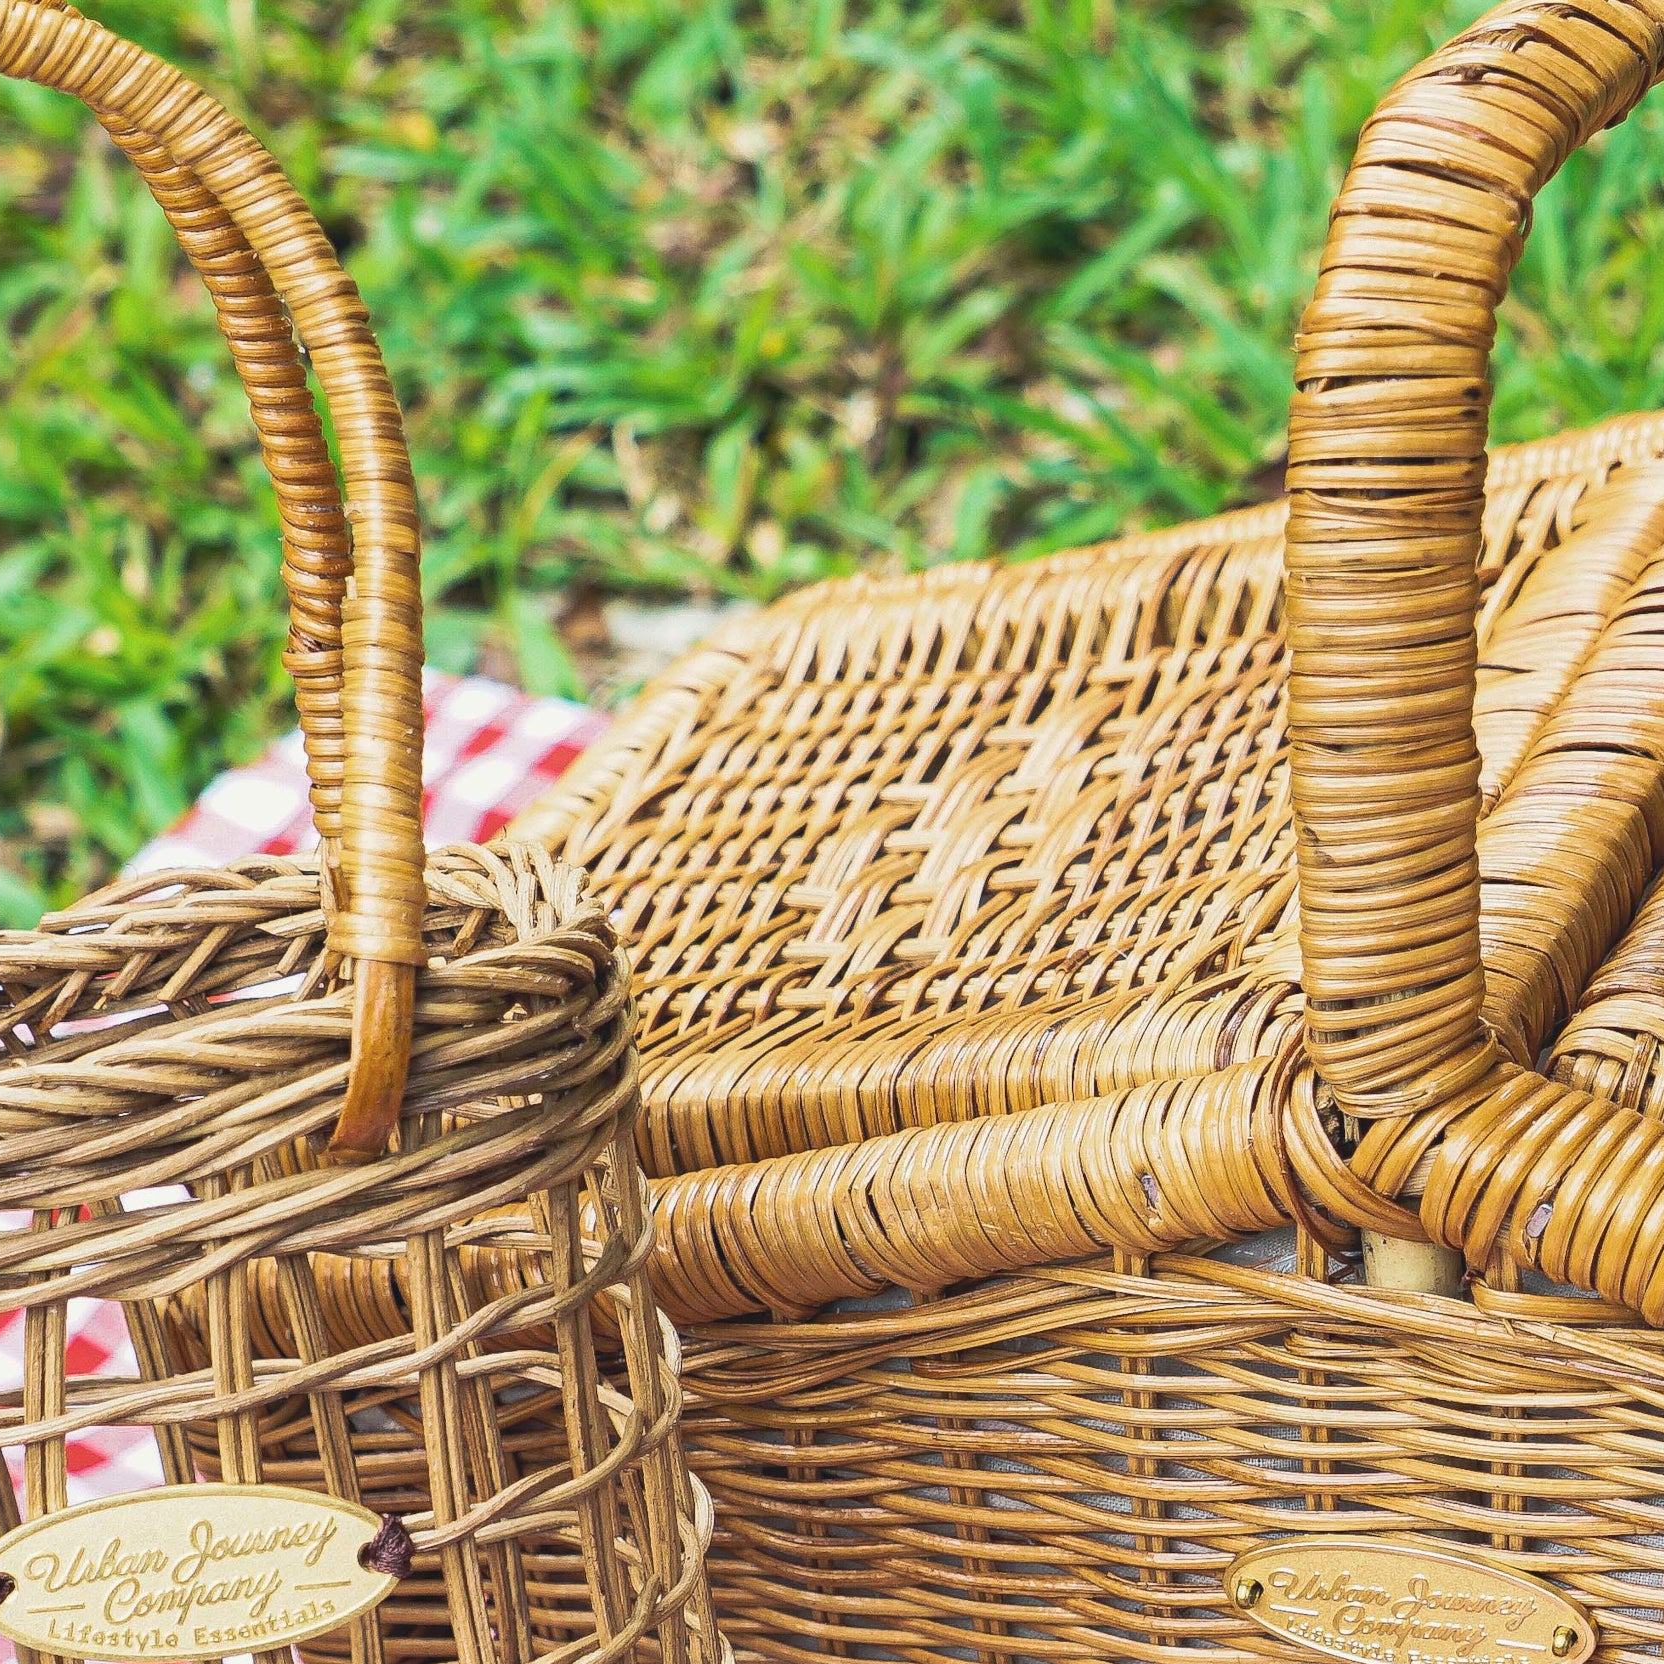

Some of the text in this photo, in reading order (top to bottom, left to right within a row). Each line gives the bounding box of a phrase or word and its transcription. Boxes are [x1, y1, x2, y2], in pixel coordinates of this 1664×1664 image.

[25, 1514, 338, 1593] Urban Journey
[103, 1566, 283, 1625] Company
[1267, 1567, 1538, 1632] Urban Journey
[48, 1600, 336, 1652] Lifestyle Essentials
[1332, 1602, 1488, 1657] Company
